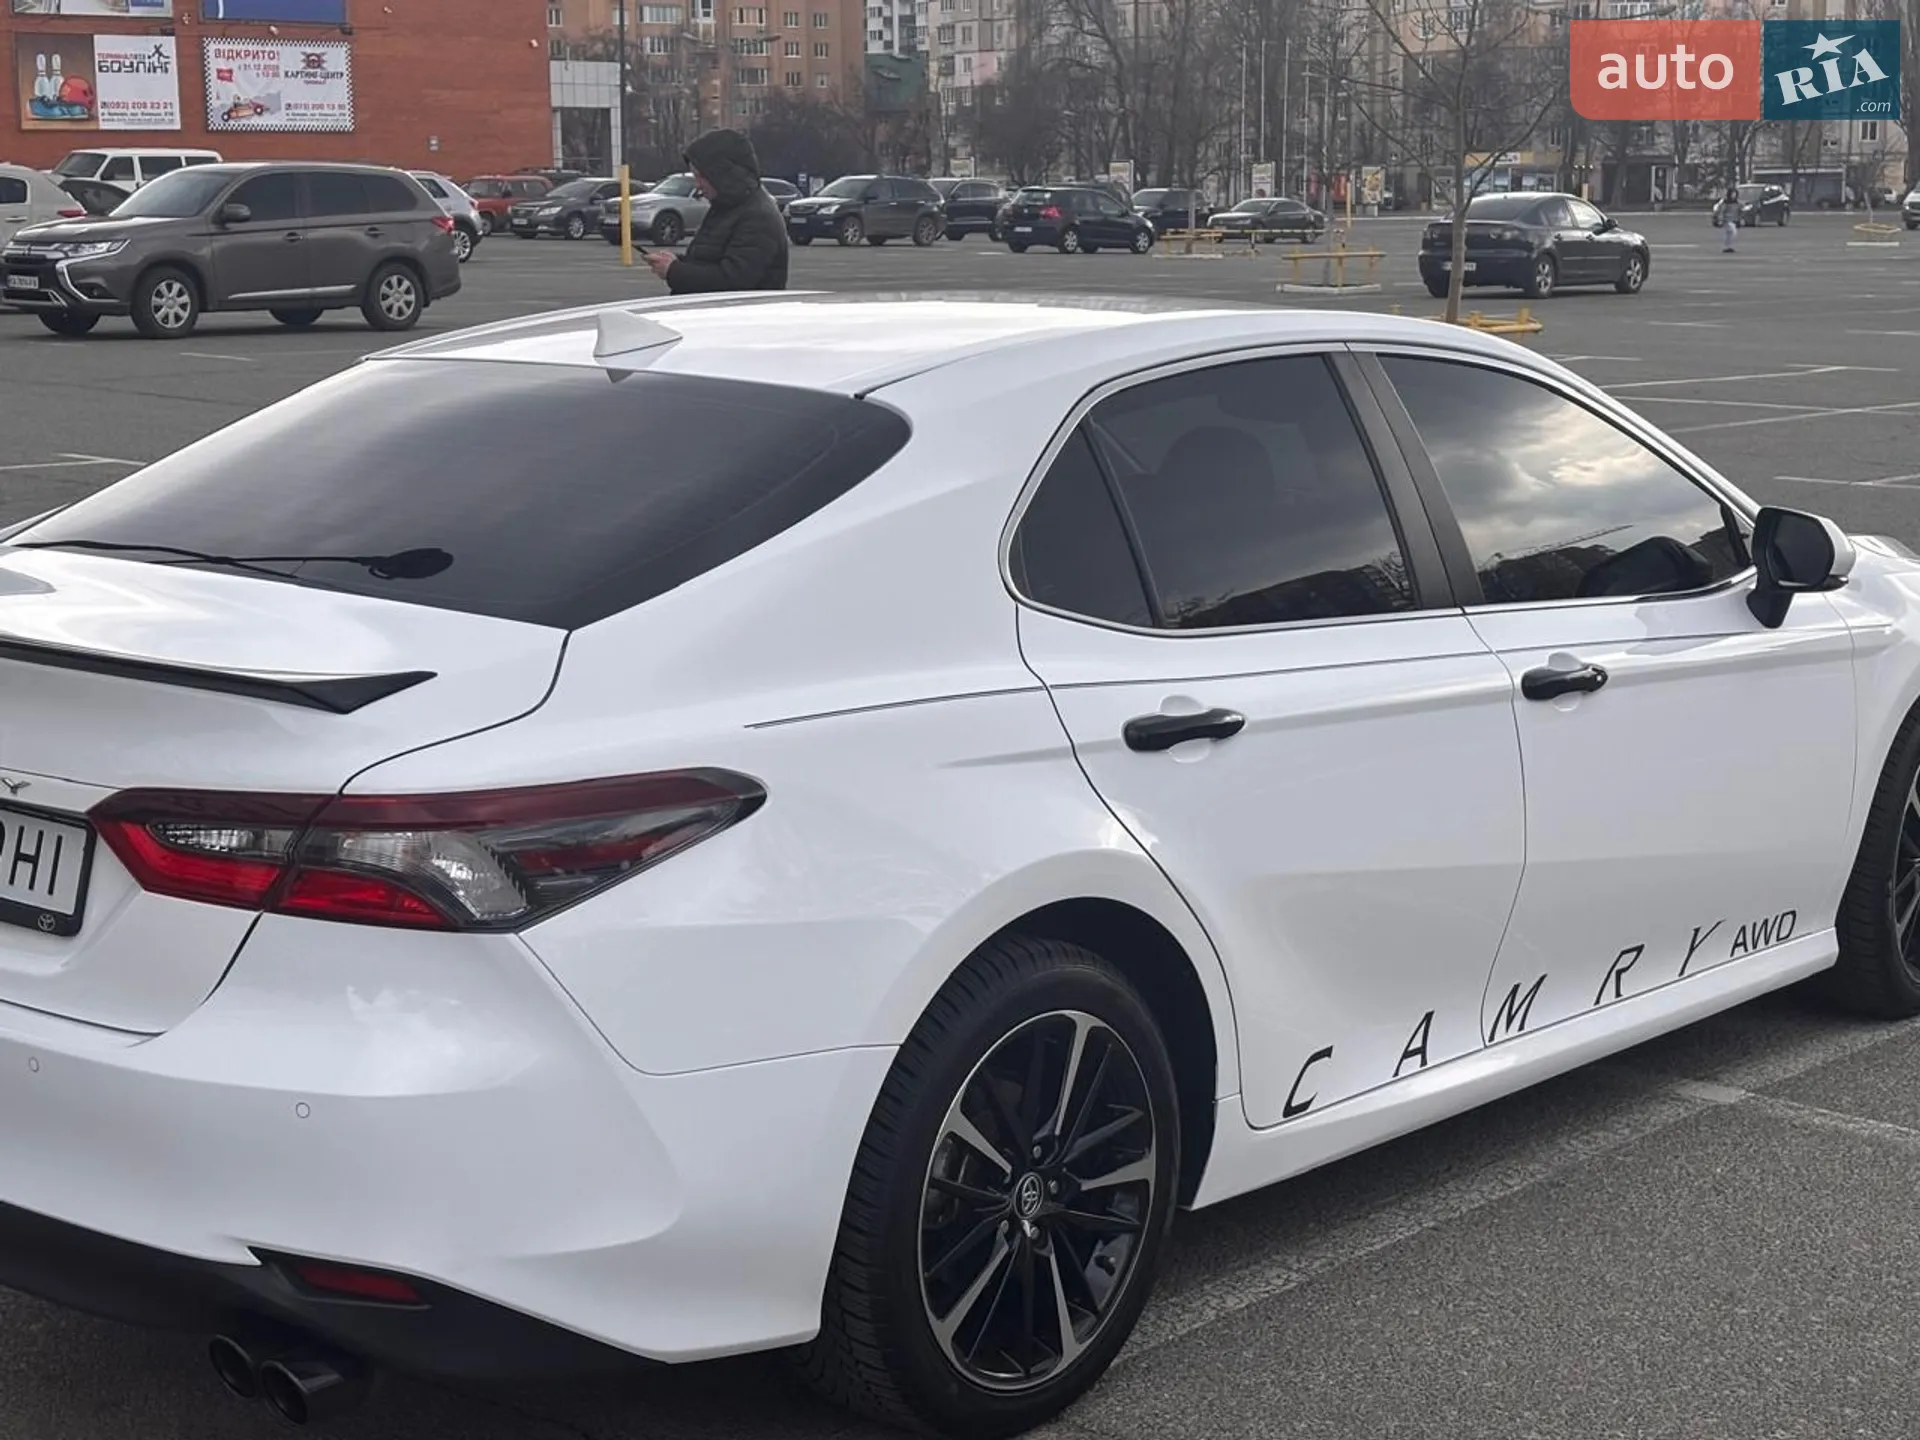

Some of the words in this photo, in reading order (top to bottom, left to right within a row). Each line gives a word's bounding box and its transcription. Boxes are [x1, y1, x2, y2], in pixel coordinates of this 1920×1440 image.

[98, 60, 170, 73] БОУЛІНГ
[214, 48, 280, 61] ВІДКРИТО!
[0, 819, 63, 896] HI
[1729, 909, 1797, 957] AWD
